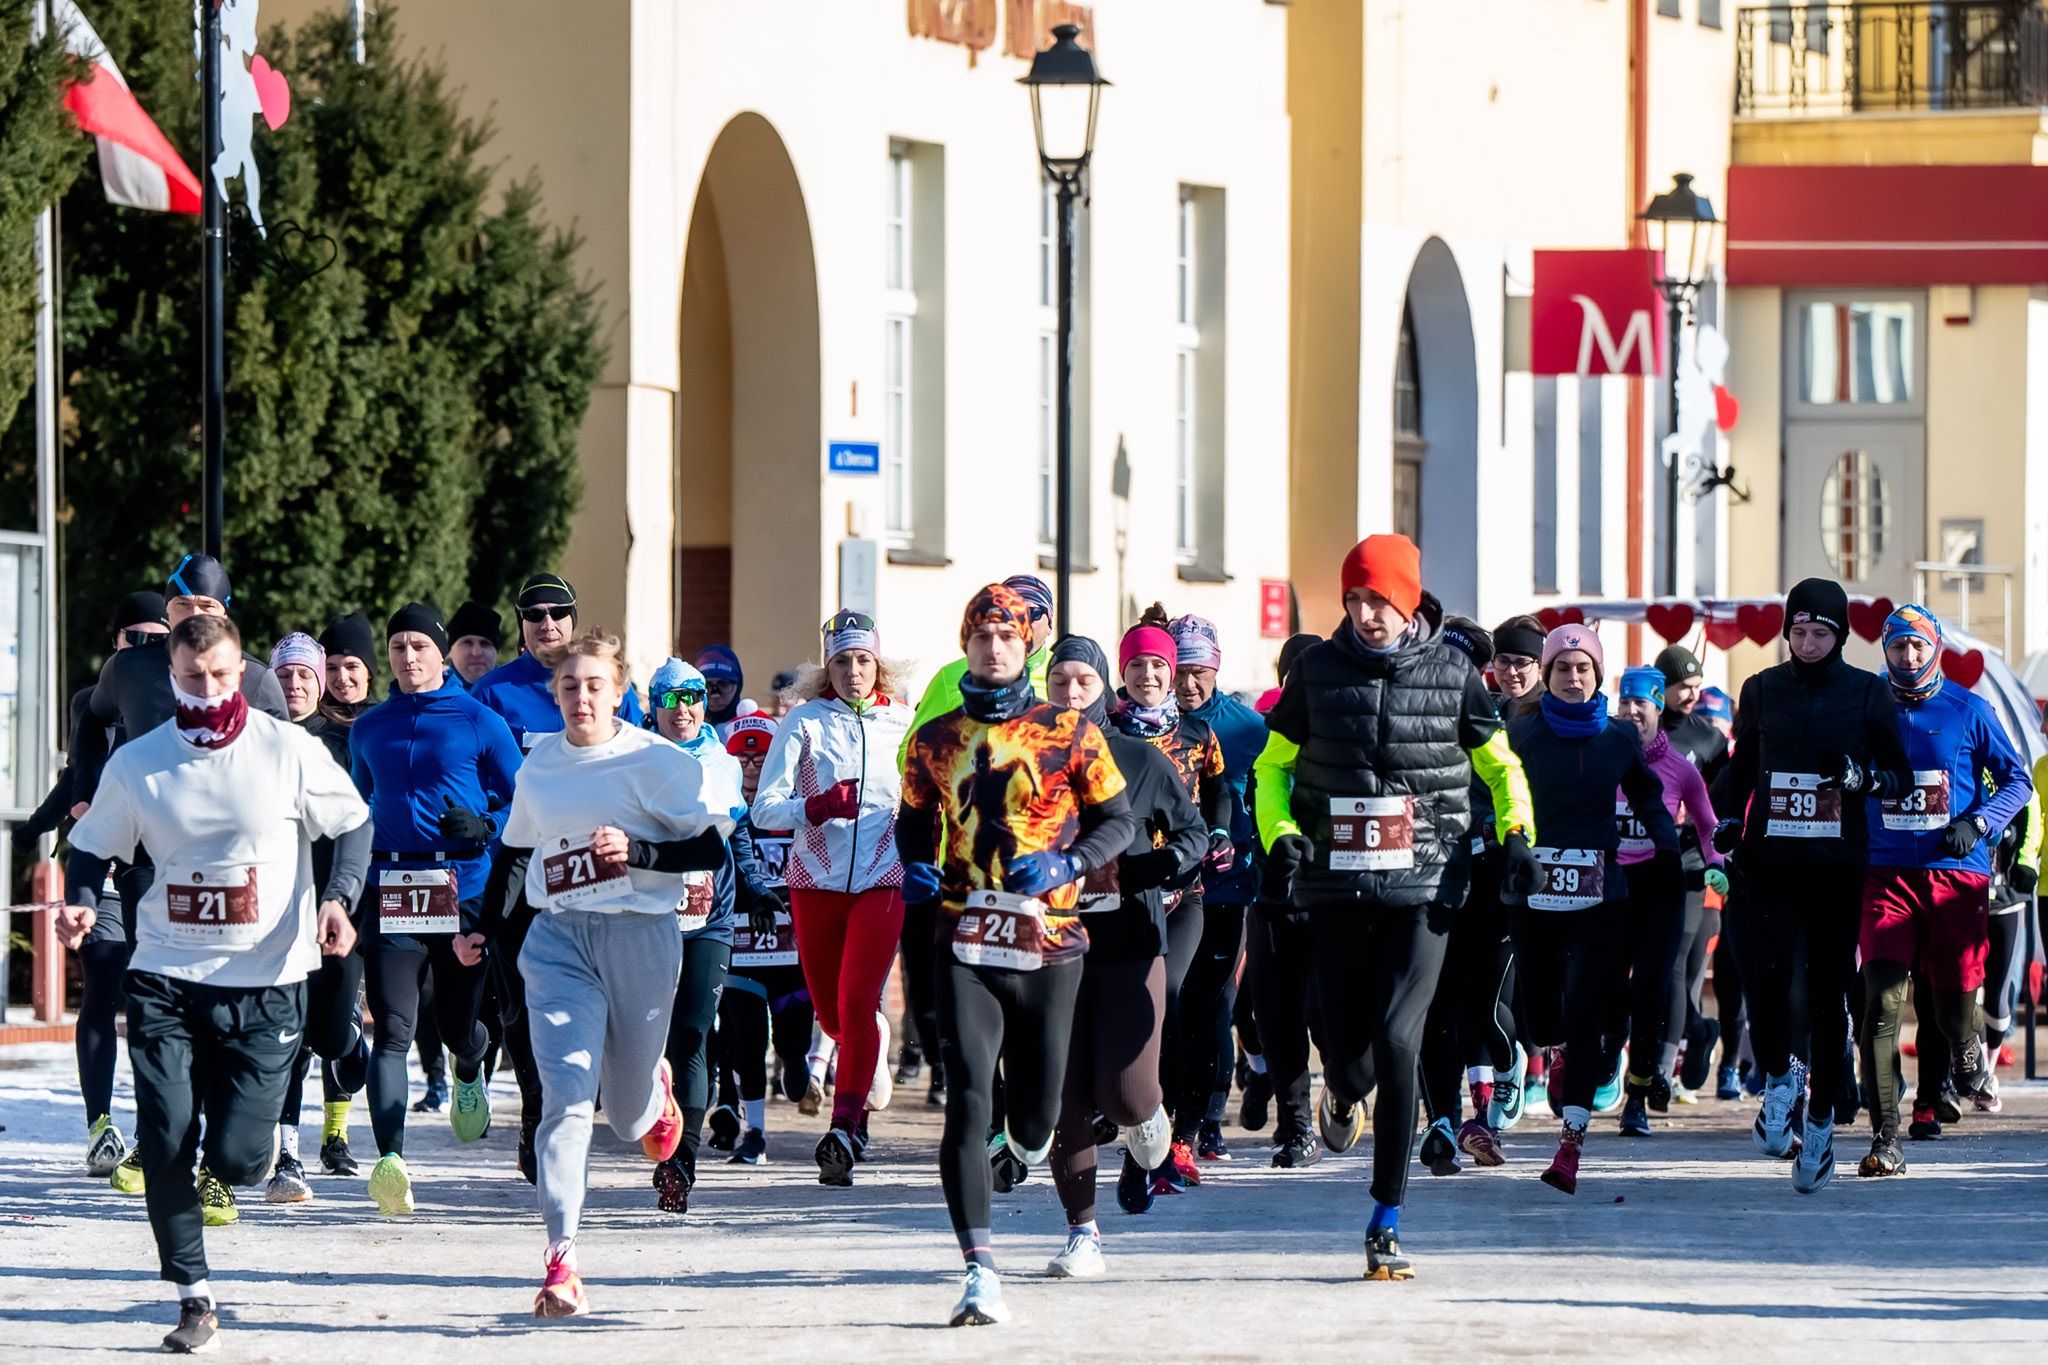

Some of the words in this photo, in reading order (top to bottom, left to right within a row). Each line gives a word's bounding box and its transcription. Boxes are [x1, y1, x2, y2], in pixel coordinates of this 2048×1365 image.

[1571, 294, 1655, 376] M
[1443, 630, 1474, 650] KIPRUN
[1789, 792, 1817, 818] 39
[1900, 788, 1927, 811] 33
[1365, 819, 1381, 848] 6
[567, 851, 597, 885] 21
[1551, 867, 1579, 892] 39
[197, 891, 227, 920] 21
[408, 889, 431, 913] 17
[754, 929, 778, 950] 25
[983, 913, 1017, 944] 24
